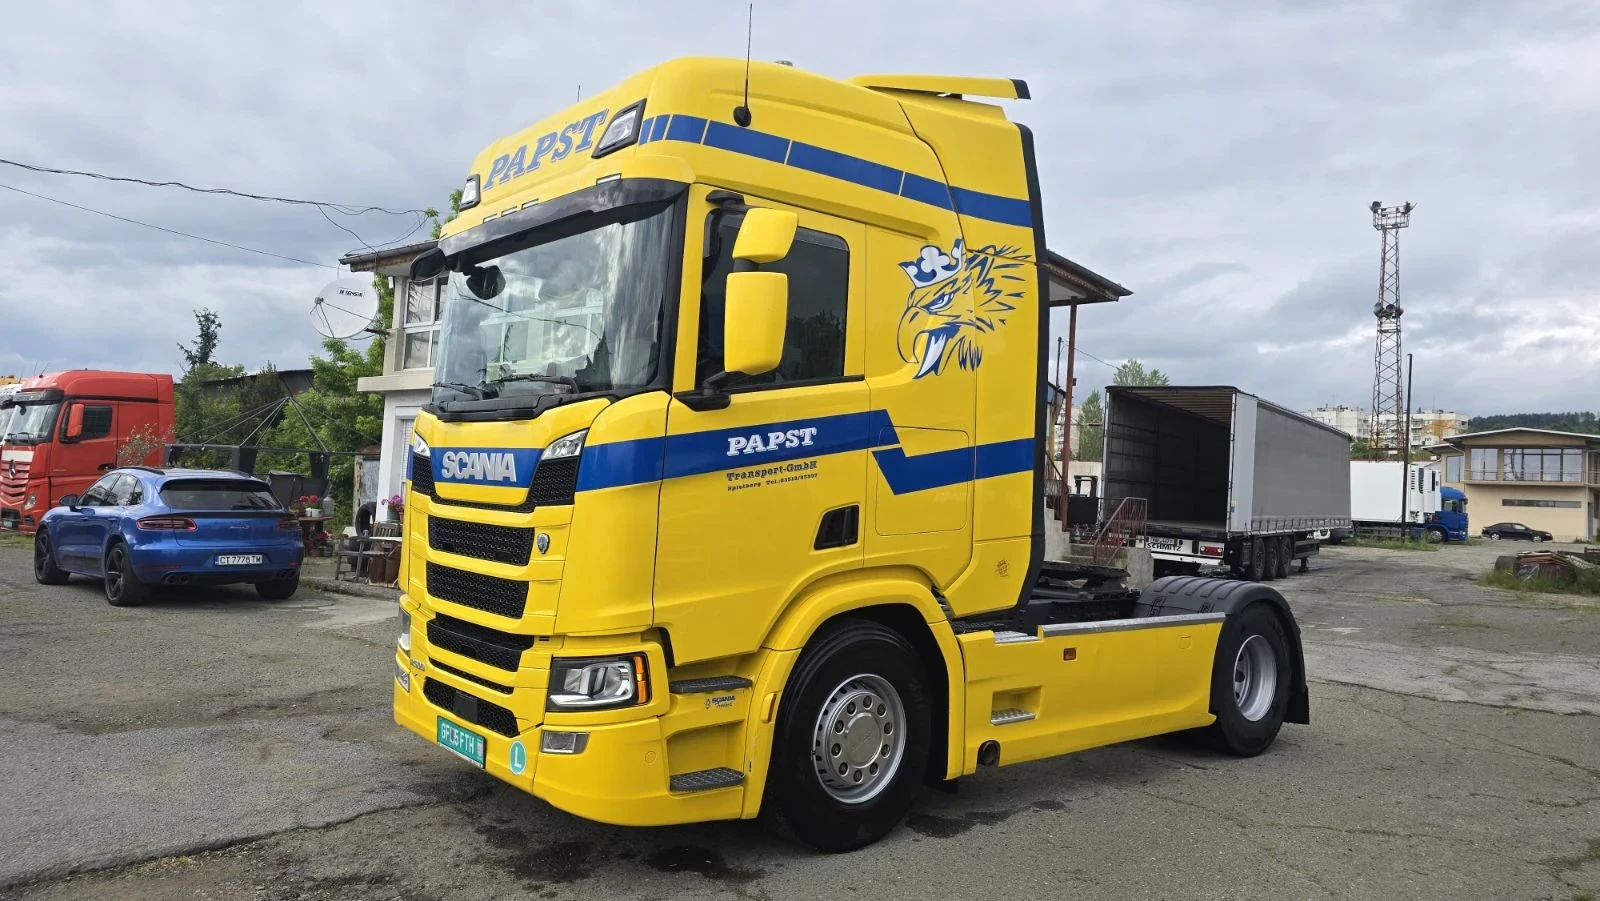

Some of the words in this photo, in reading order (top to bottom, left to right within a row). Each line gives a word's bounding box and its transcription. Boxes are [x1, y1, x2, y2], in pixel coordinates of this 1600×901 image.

[482, 108, 609, 191] PAPST
[726, 427, 817, 456] PAPST
[441, 451, 517, 482] SCANIA
[726, 460, 817, 481] Transport-GmbH
[1147, 543, 1182, 551] SCHMITZ
[514, 746, 522, 769] L
